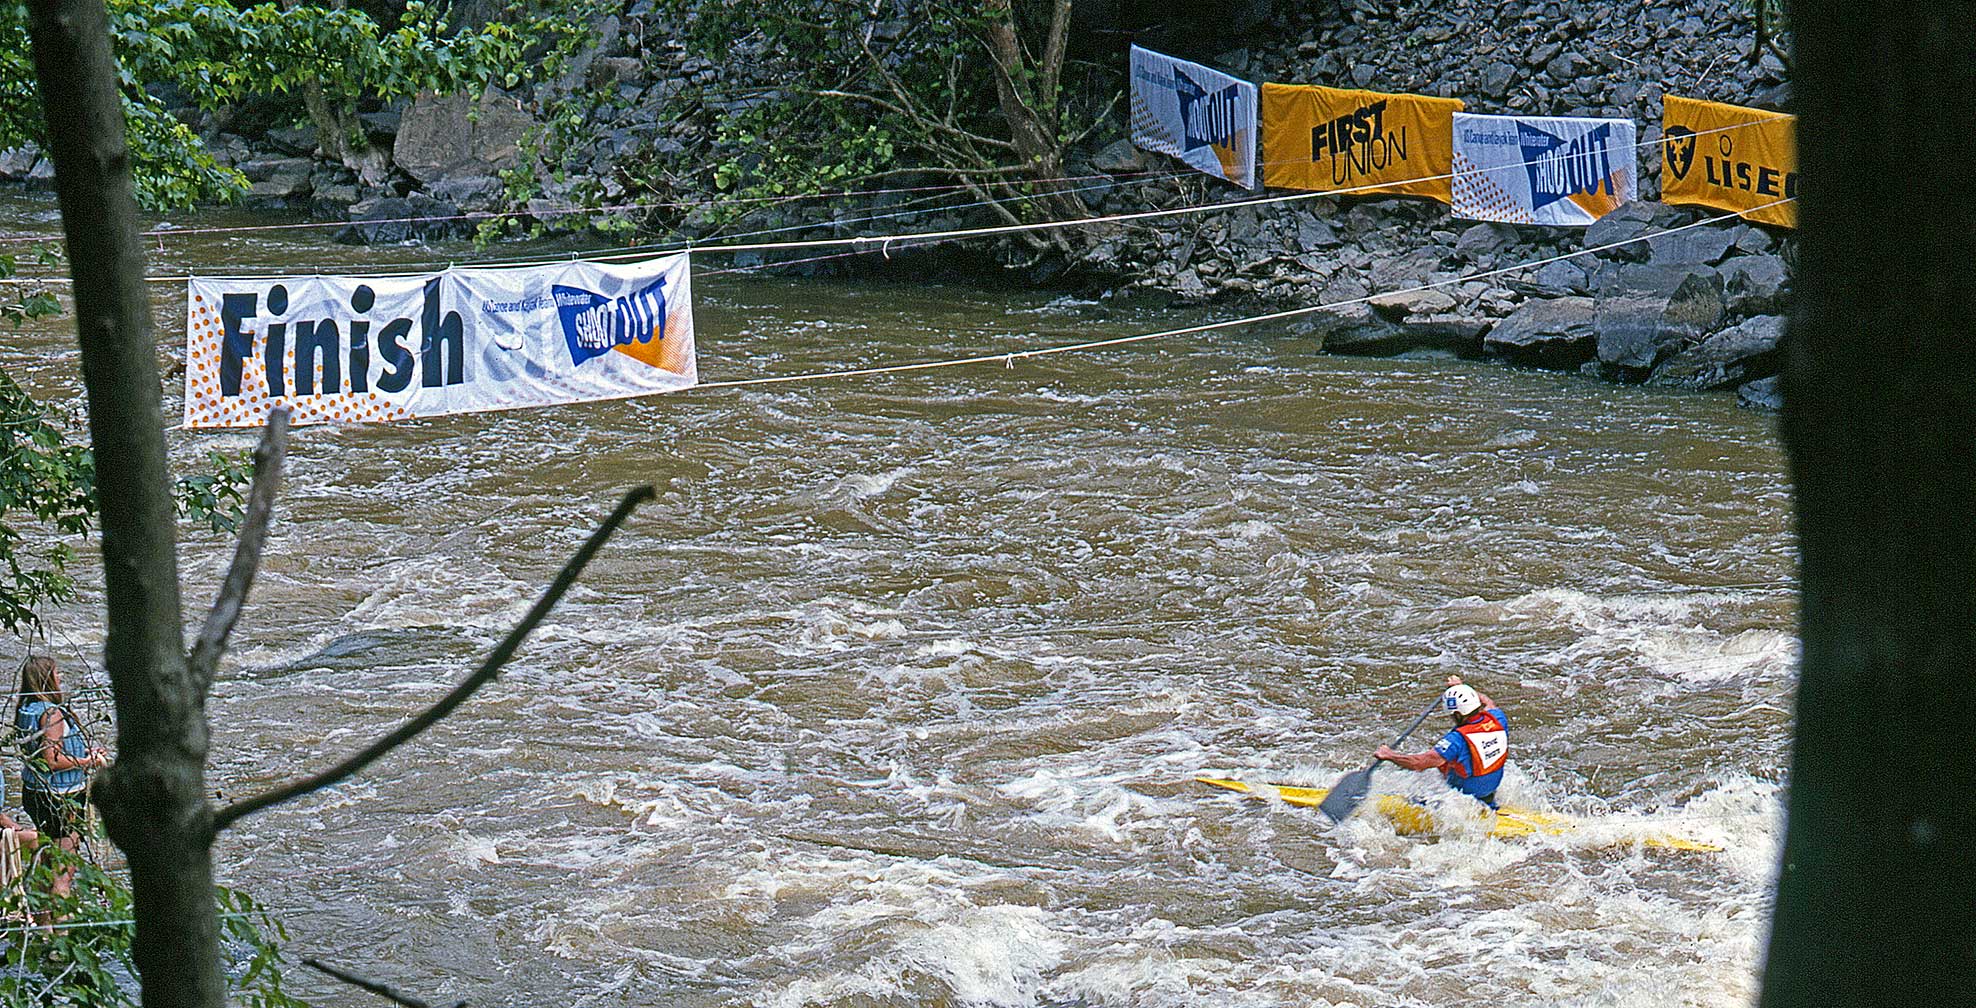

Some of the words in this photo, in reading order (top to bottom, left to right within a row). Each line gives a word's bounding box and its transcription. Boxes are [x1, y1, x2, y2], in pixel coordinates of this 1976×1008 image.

[1312, 100, 1387, 161] FIRST
[1332, 126, 1407, 185] UNION
[220, 277, 464, 397] Finish
[575, 276, 667, 350] SHOOTOUT
